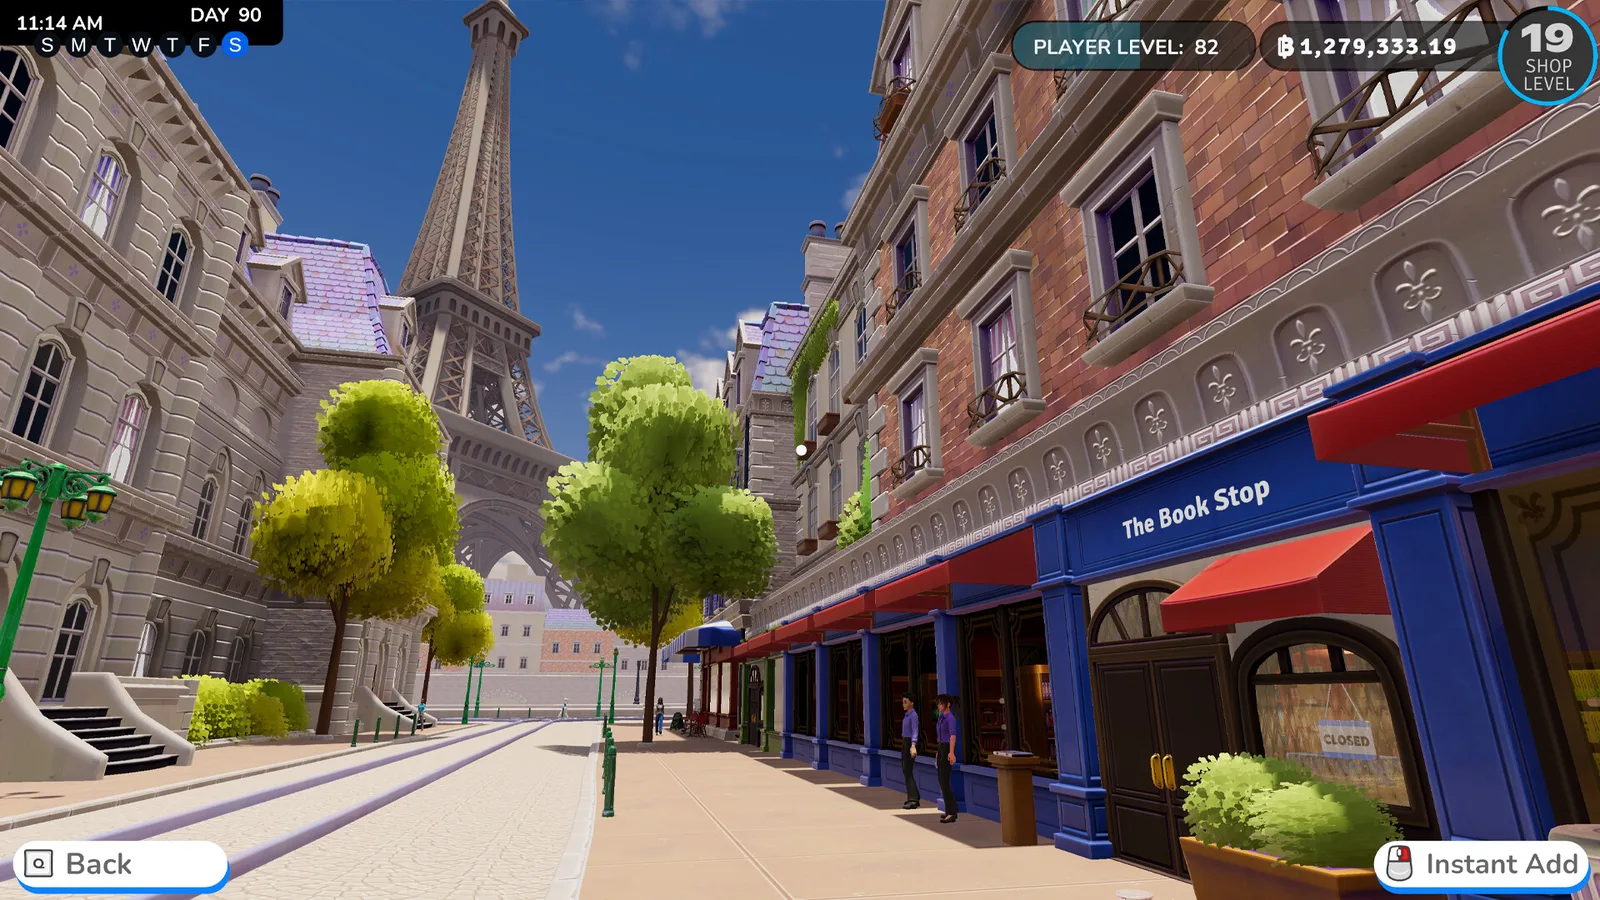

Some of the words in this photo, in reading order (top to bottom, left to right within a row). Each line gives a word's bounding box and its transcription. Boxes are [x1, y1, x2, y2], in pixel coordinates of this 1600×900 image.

[1122, 516, 1154, 539] The
[1158, 495, 1210, 529] Book
[1213, 479, 1270, 506] Stop
[1323, 733, 1371, 748] CLOSED
